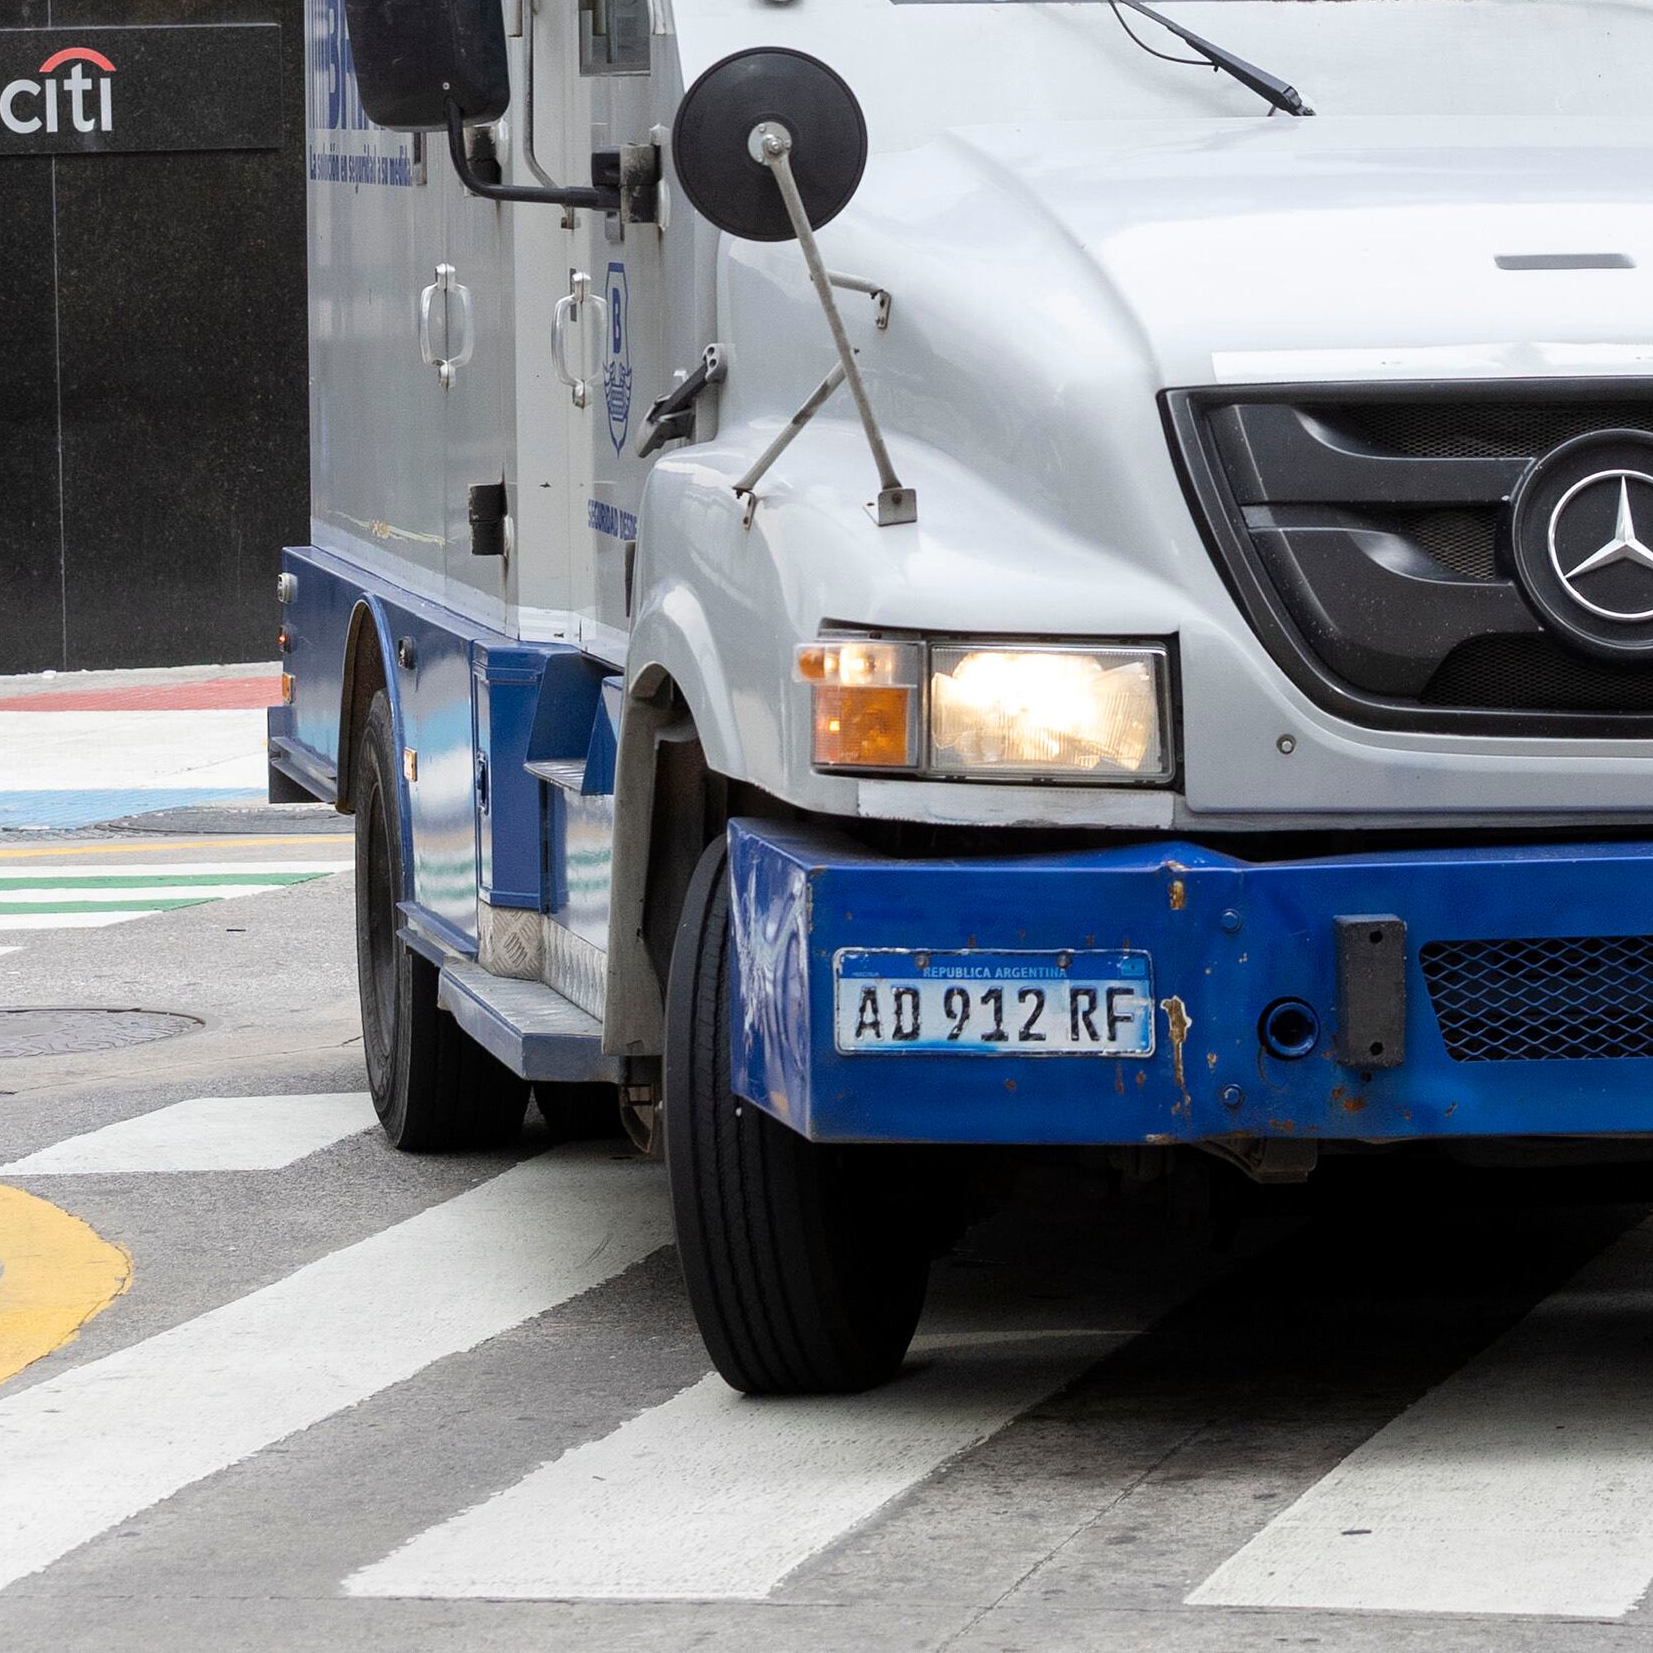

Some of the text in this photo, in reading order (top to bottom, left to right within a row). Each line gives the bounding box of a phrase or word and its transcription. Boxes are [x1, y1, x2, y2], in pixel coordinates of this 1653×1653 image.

[0, 62, 113, 134] citi
[349, 144, 377, 194] seguridad
[612, 287, 621, 354] B
[923, 966, 1067, 978] REPUBLICA ARGENTINA
[855, 985, 1135, 1042] AD 912 RF
